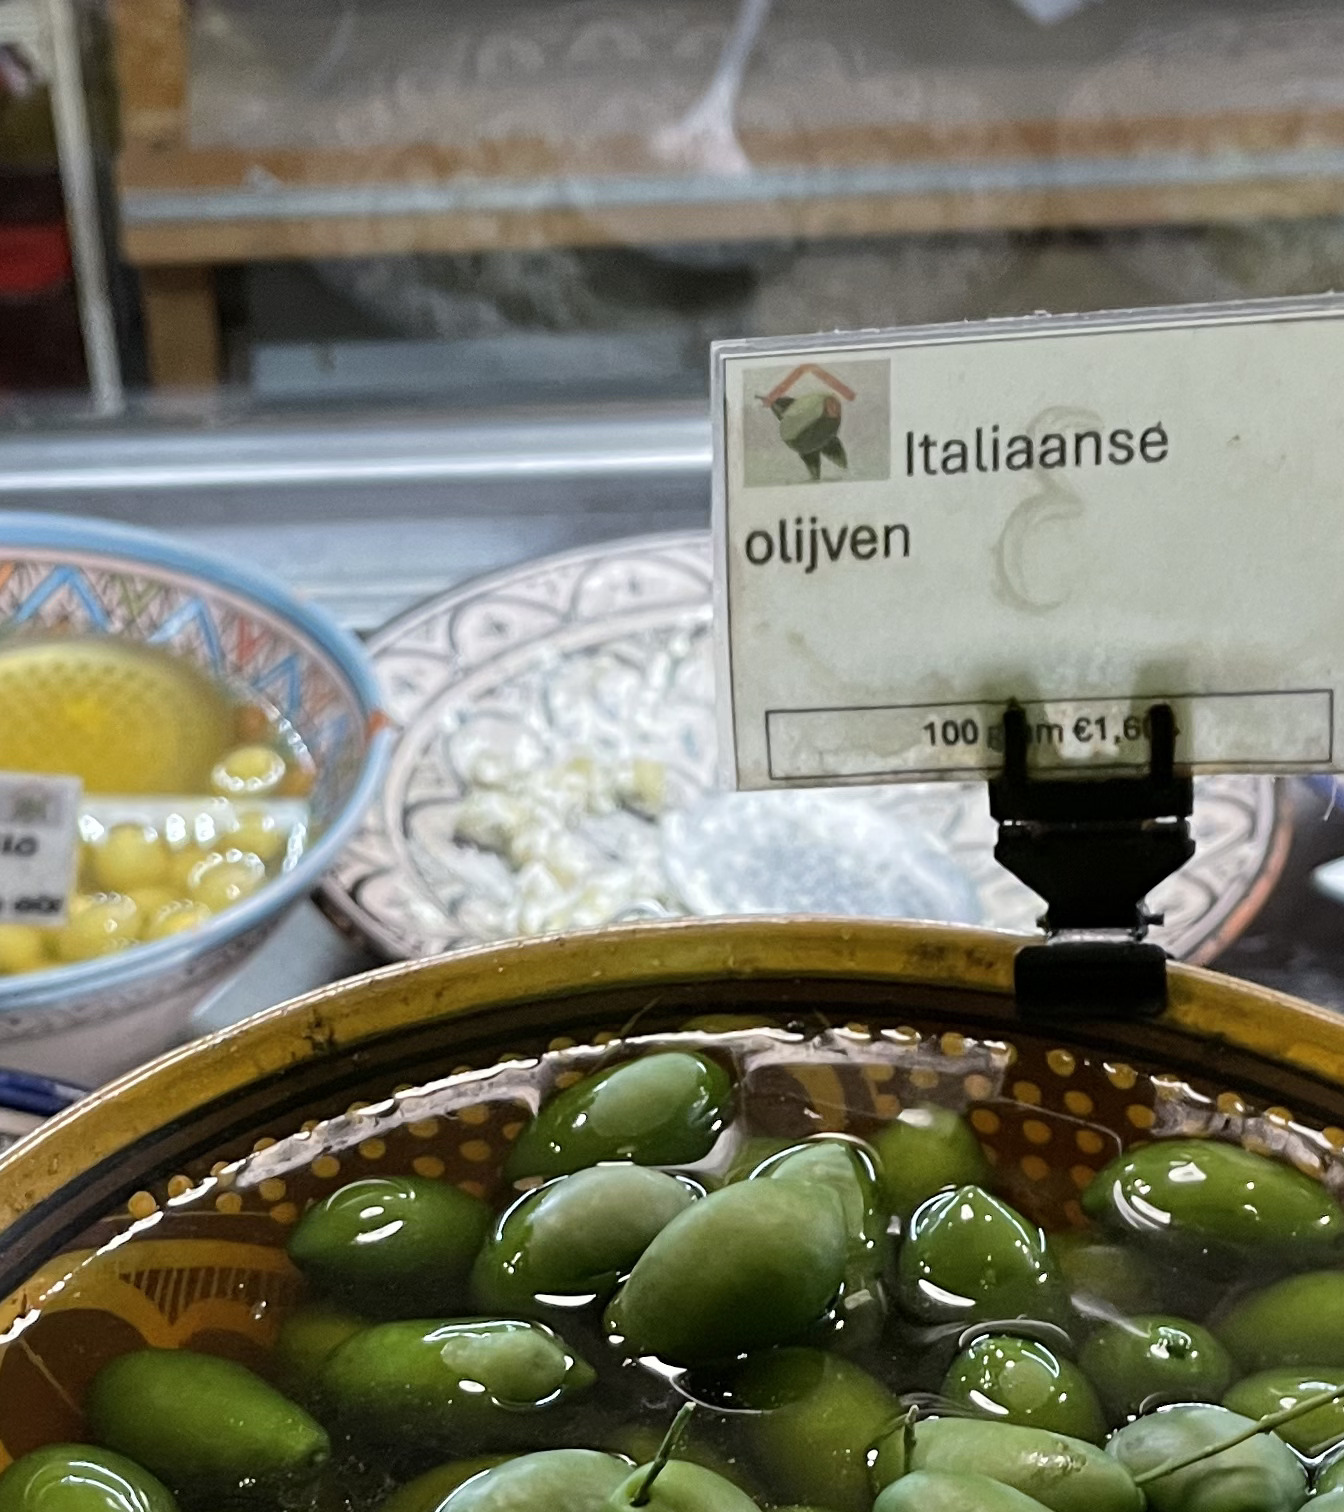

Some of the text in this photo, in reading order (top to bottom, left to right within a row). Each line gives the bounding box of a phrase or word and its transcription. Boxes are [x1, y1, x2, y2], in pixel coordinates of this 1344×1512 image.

[905, 422, 1169, 477] Italiaanse
[745, 516, 910, 574] olijven
[922, 717, 979, 746] 100
[987, 721, 1065, 751] gm
